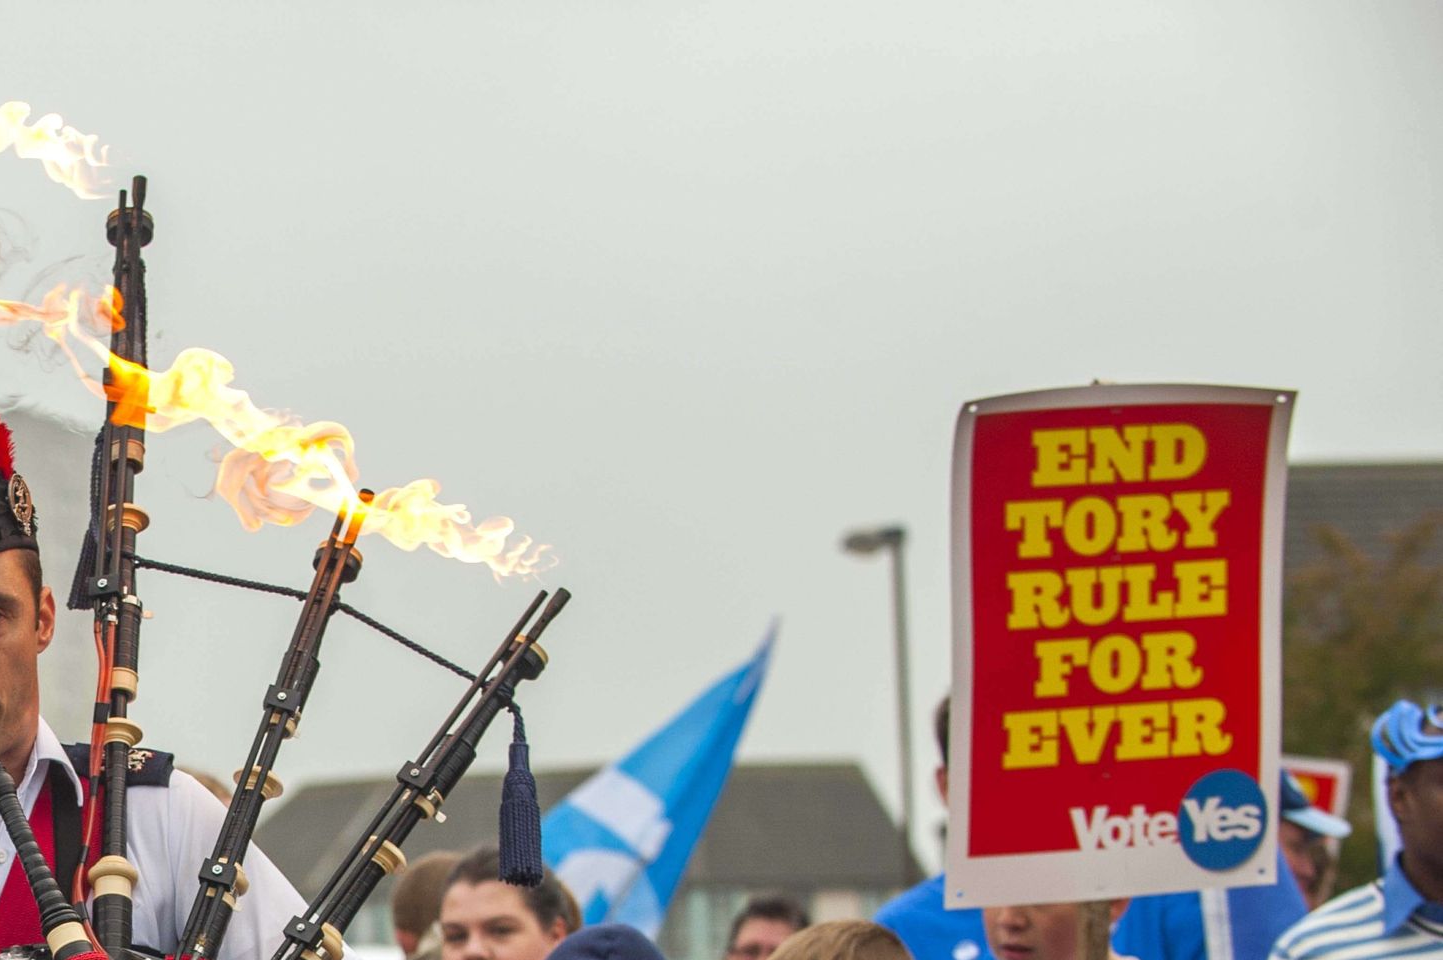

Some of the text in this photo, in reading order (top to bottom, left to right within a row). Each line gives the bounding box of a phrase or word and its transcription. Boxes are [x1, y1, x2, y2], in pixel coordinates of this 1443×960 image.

[1031, 423, 1208, 487] END
[1005, 490, 1231, 559] TORY
[1007, 558, 1228, 630] RULE
[1034, 630, 1204, 698] FOR
[1002, 697, 1233, 770] EVER
[1069, 796, 1262, 850] Vote Yes
